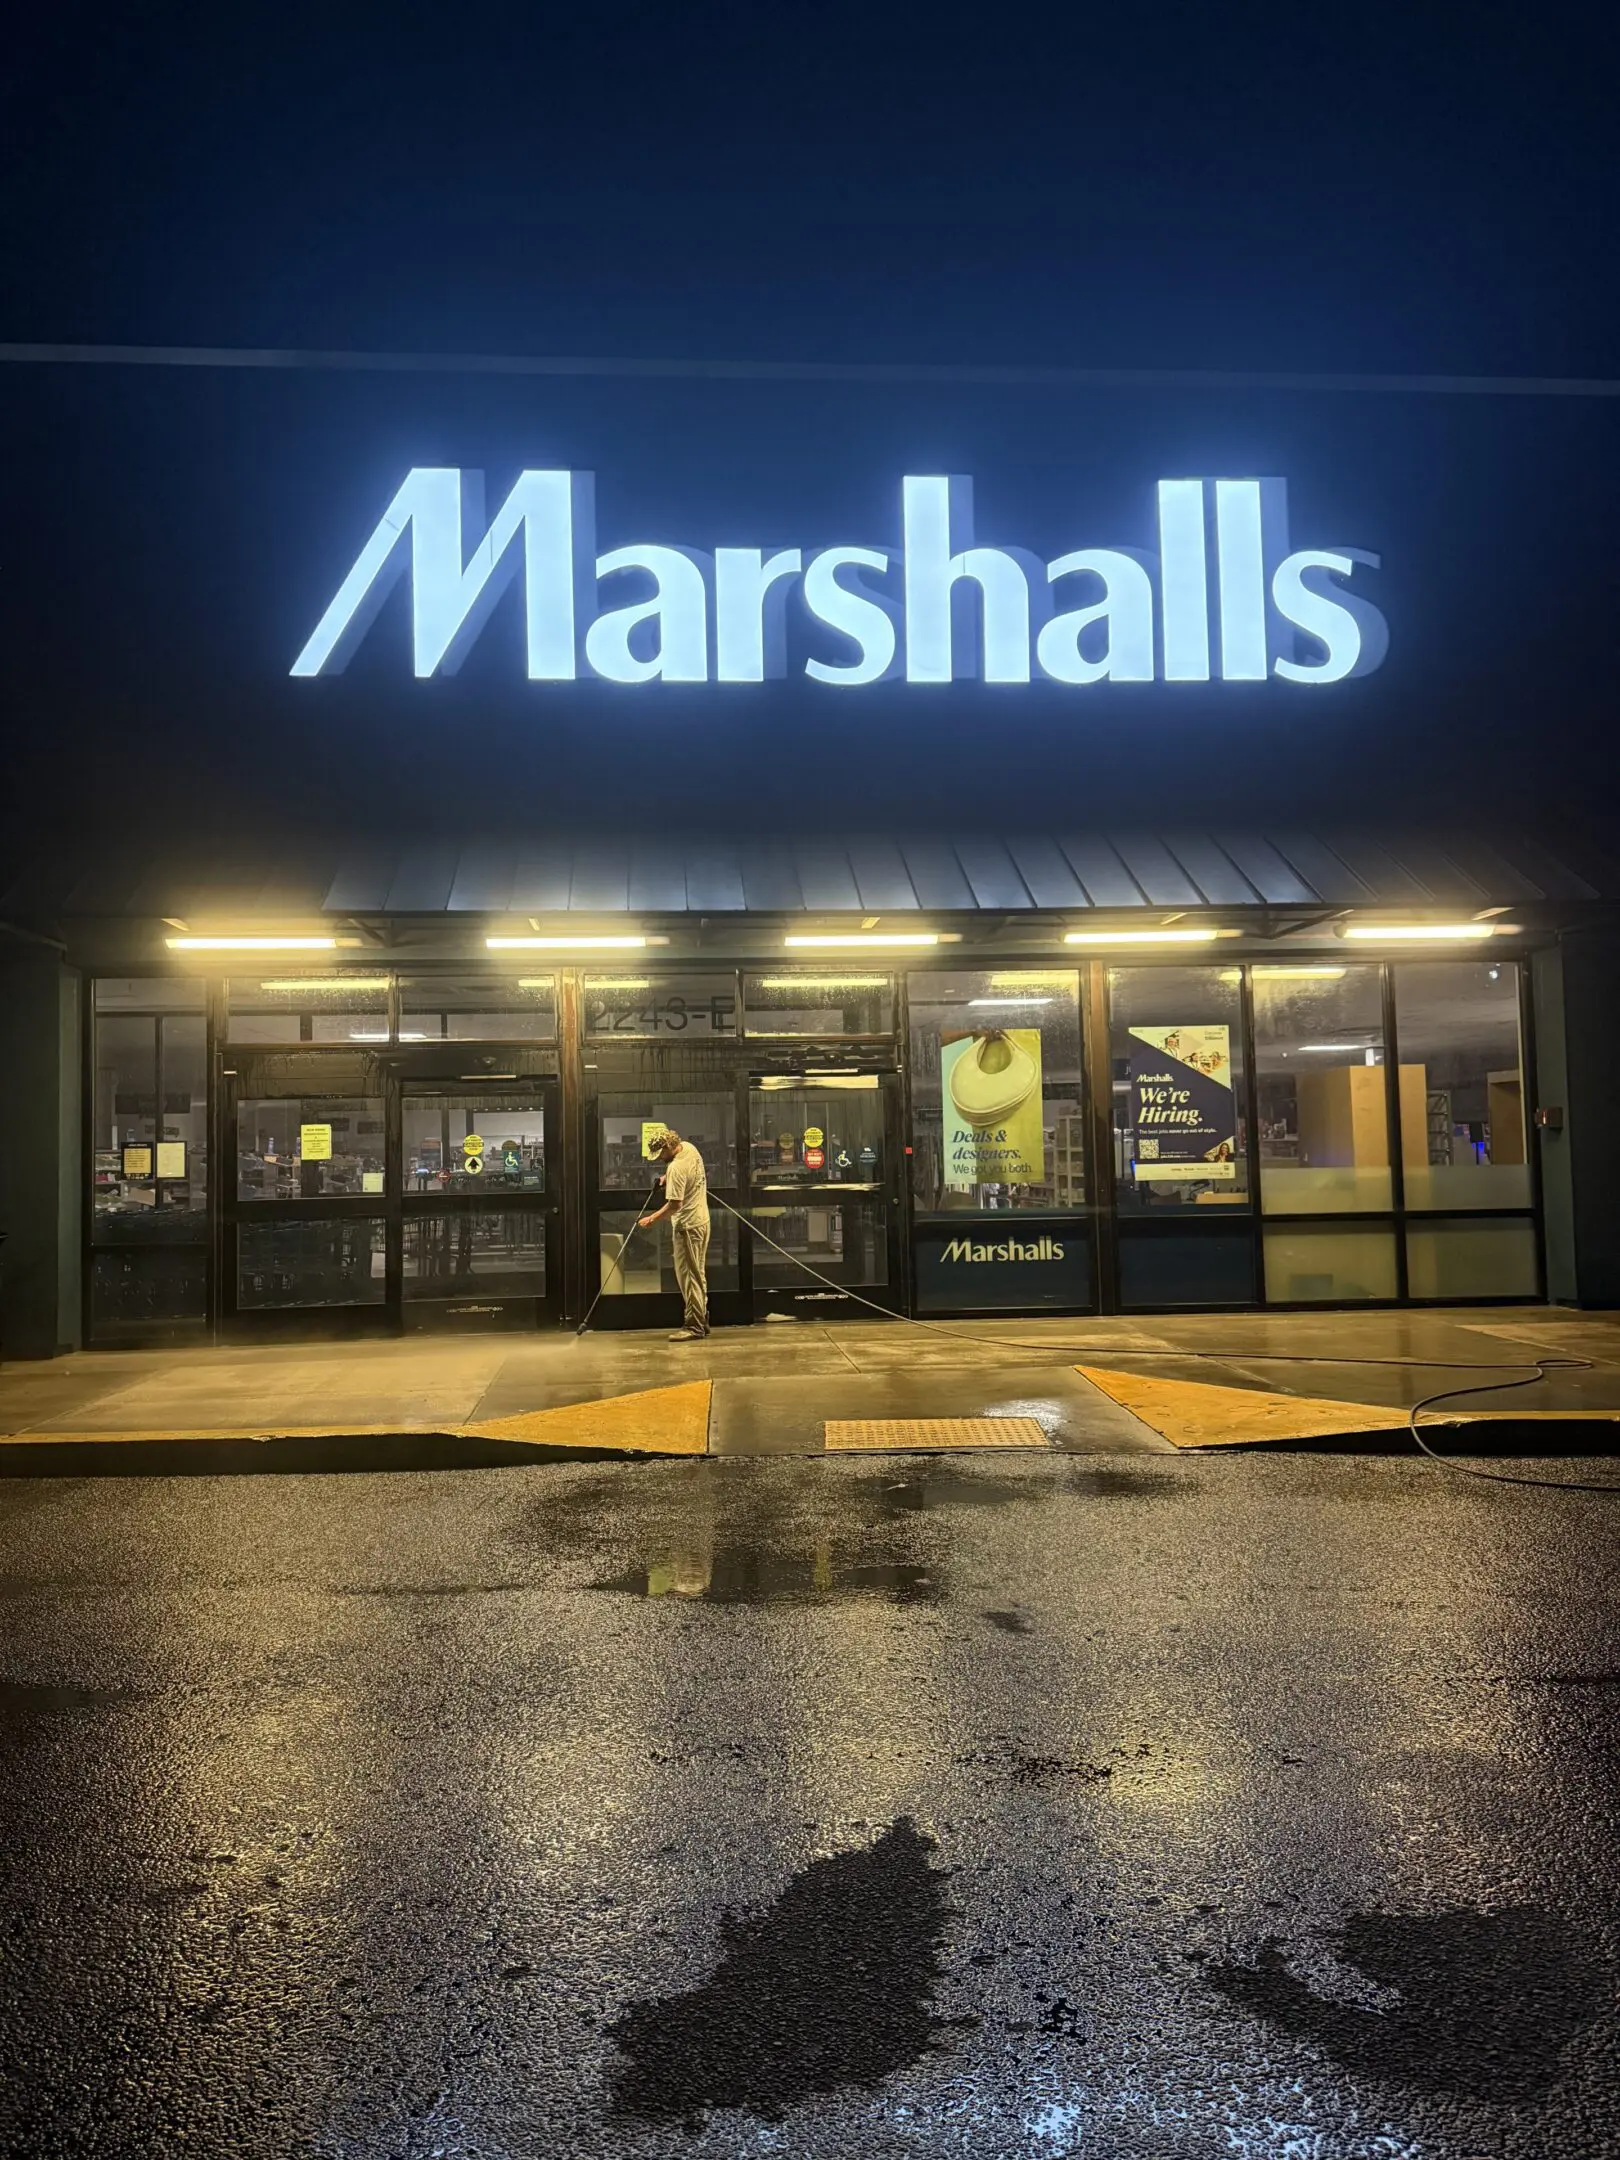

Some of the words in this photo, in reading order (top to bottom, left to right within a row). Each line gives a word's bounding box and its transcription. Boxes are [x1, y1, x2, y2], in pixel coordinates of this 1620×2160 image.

[289, 467, 1361, 685] Marshalls
[591, 996, 735, 1031] 2243-E
[1136, 1073, 1174, 1083] Marshalls
[1140, 1087, 1190, 1104] We're
[1138, 1106, 1203, 1126] Hiring.
[952, 1130, 993, 1143] Deals
[995, 1129, 1007, 1142] &
[952, 1147, 1022, 1162] designers.
[953, 1164, 970, 1174] We
[971, 1164, 987, 1175] got
[988, 1165, 1007, 1176] you
[940, 1235, 1065, 1263] Marshalls
